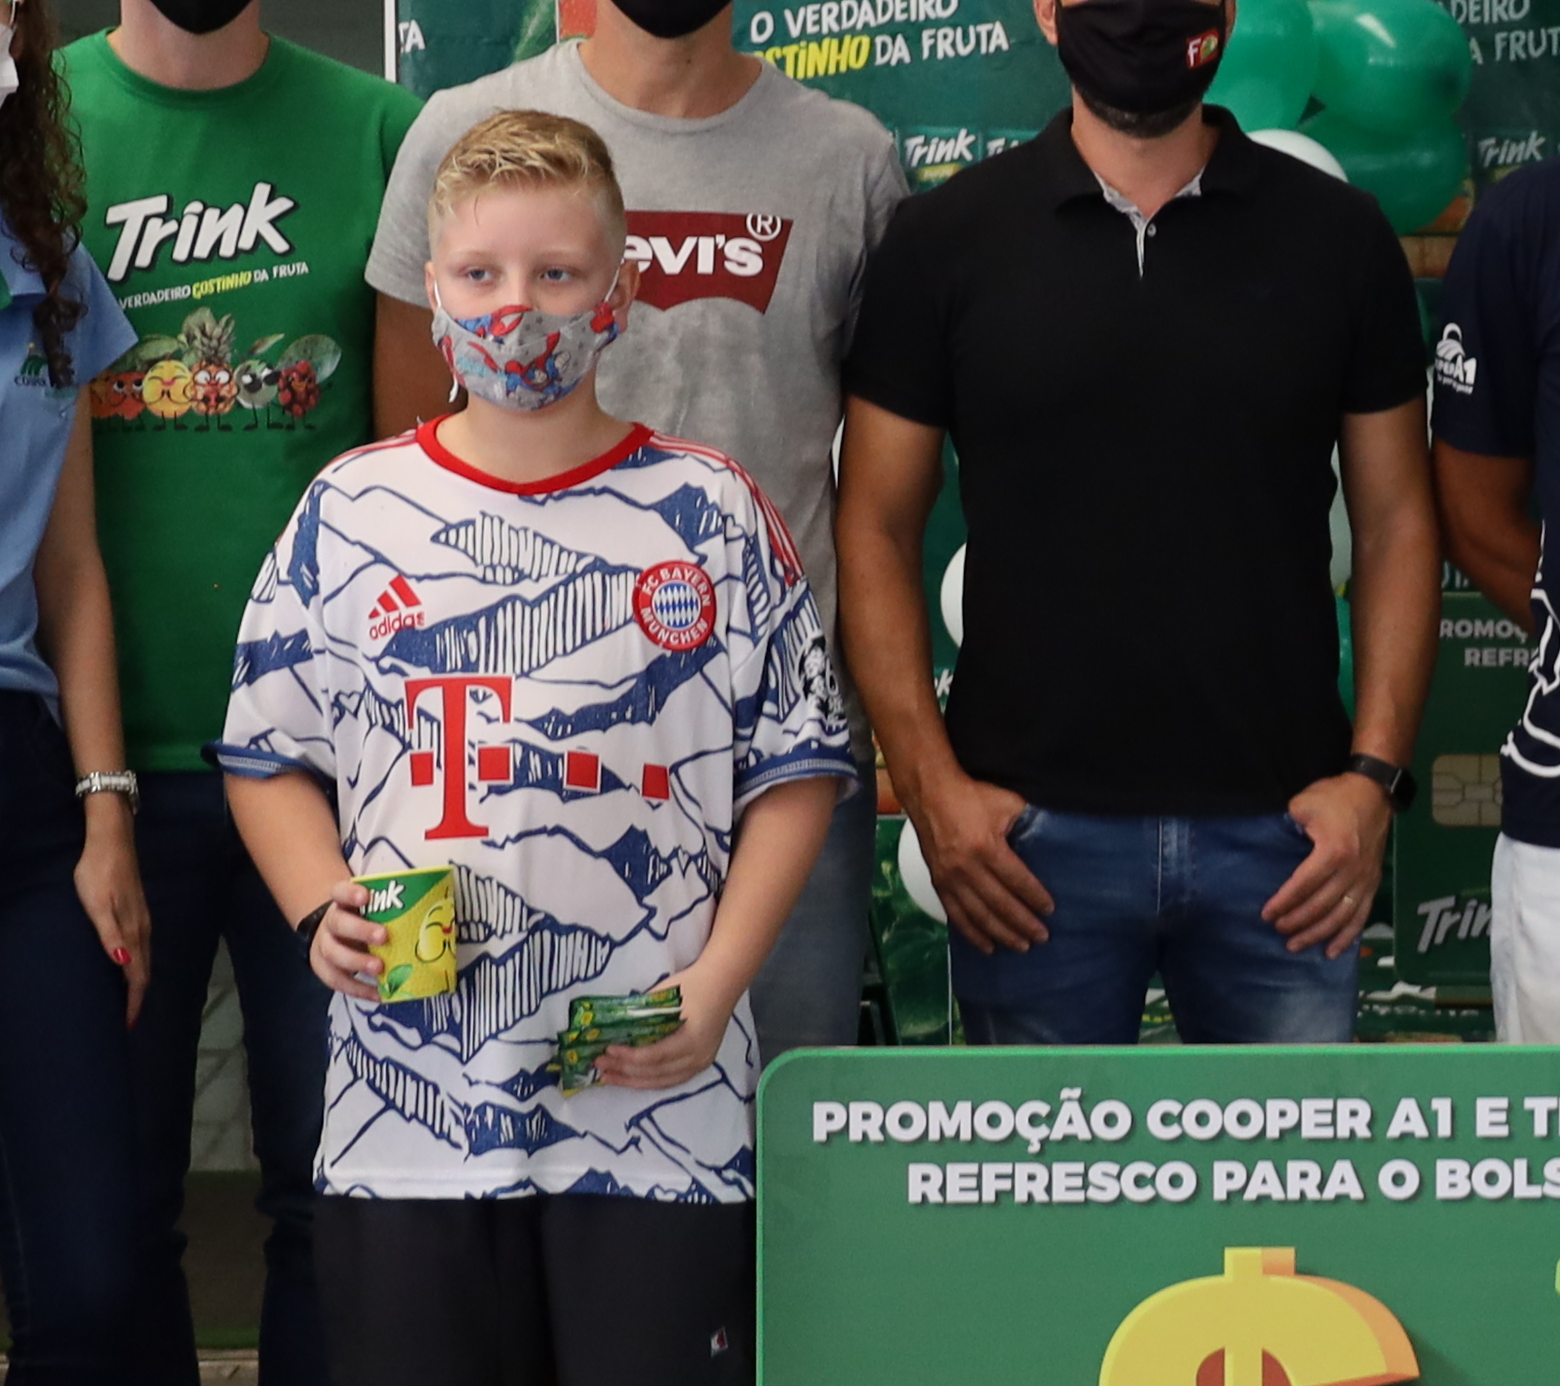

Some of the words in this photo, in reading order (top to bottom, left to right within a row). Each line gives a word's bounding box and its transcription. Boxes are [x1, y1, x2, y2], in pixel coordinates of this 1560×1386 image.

[751, 11, 774, 44] O
[875, 35, 911, 66] DA
[922, 21, 1009, 61] FRUTA
[905, 128, 976, 168] Trink
[1477, 130, 1546, 168] Trink
[105, 182, 295, 282] Trink
[624, 234, 764, 277] evi's
[119, 284, 191, 310] VERDADEIRO
[254, 270, 269, 283] DA
[273, 262, 309, 279] FRUTA
[642, 574, 660, 596] FC
[659, 566, 711, 608] BAYERN
[369, 610, 425, 641] adidas
[360, 880, 405, 915] ink
[813, 1087, 1132, 1154] PROMOÇÃO
[1146, 1097, 1372, 1142] COOPER
[1386, 1097, 1453, 1139] A1
[1476, 1097, 1510, 1139] E
[908, 1160, 1198, 1204] REFRESCO
[1214, 1159, 1365, 1201] PARA
[1378, 1158, 1421, 1201] O
